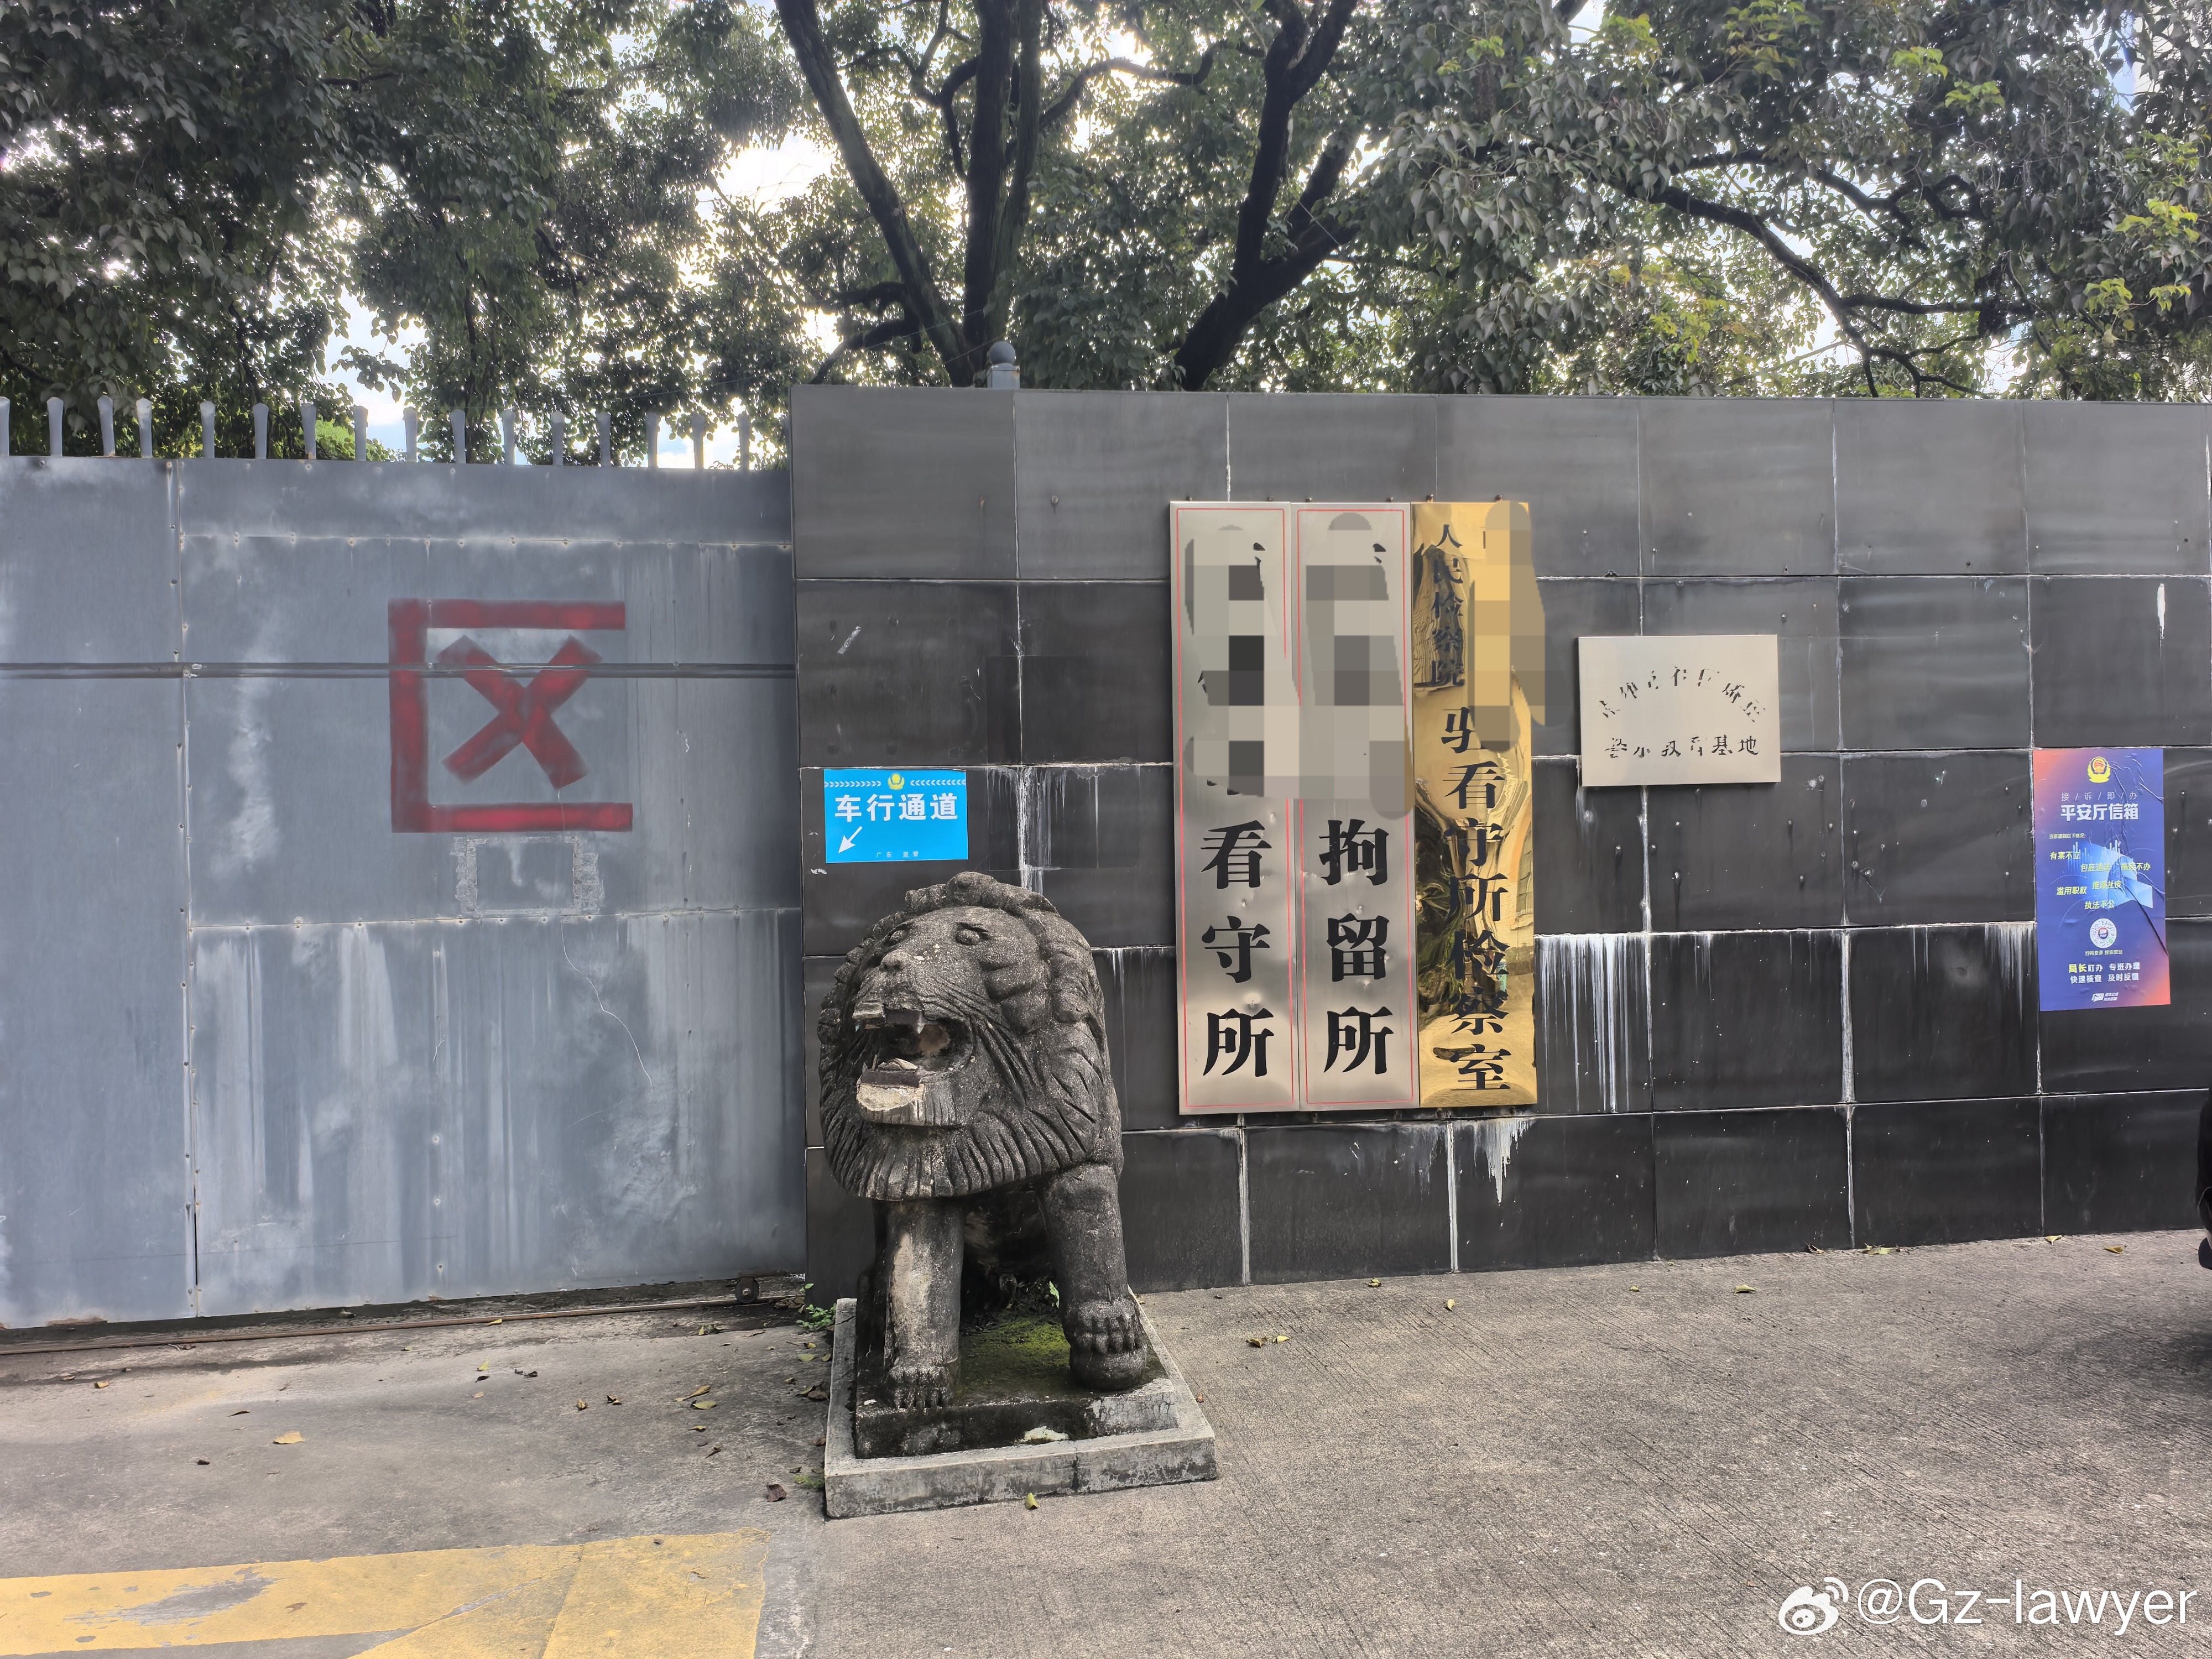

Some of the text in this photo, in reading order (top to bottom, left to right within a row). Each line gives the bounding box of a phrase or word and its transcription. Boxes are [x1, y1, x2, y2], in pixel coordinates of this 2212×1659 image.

[834, 792, 958, 822] 车行通道
[2060, 803, 2138, 822] 平安厅信箱
[2049, 851, 2081, 860] 有案不立
[2056, 886, 2087, 896] 滥用职权
[2084, 900, 2115, 910] 执法不公
[1200, 820, 1274, 1077] 看守所
[1319, 818, 1394, 1074] 拘留所
[2068, 962, 2140, 973] 局长盯办 专班办理
[2070, 973, 2140, 984] 快速核查 及时反馈
